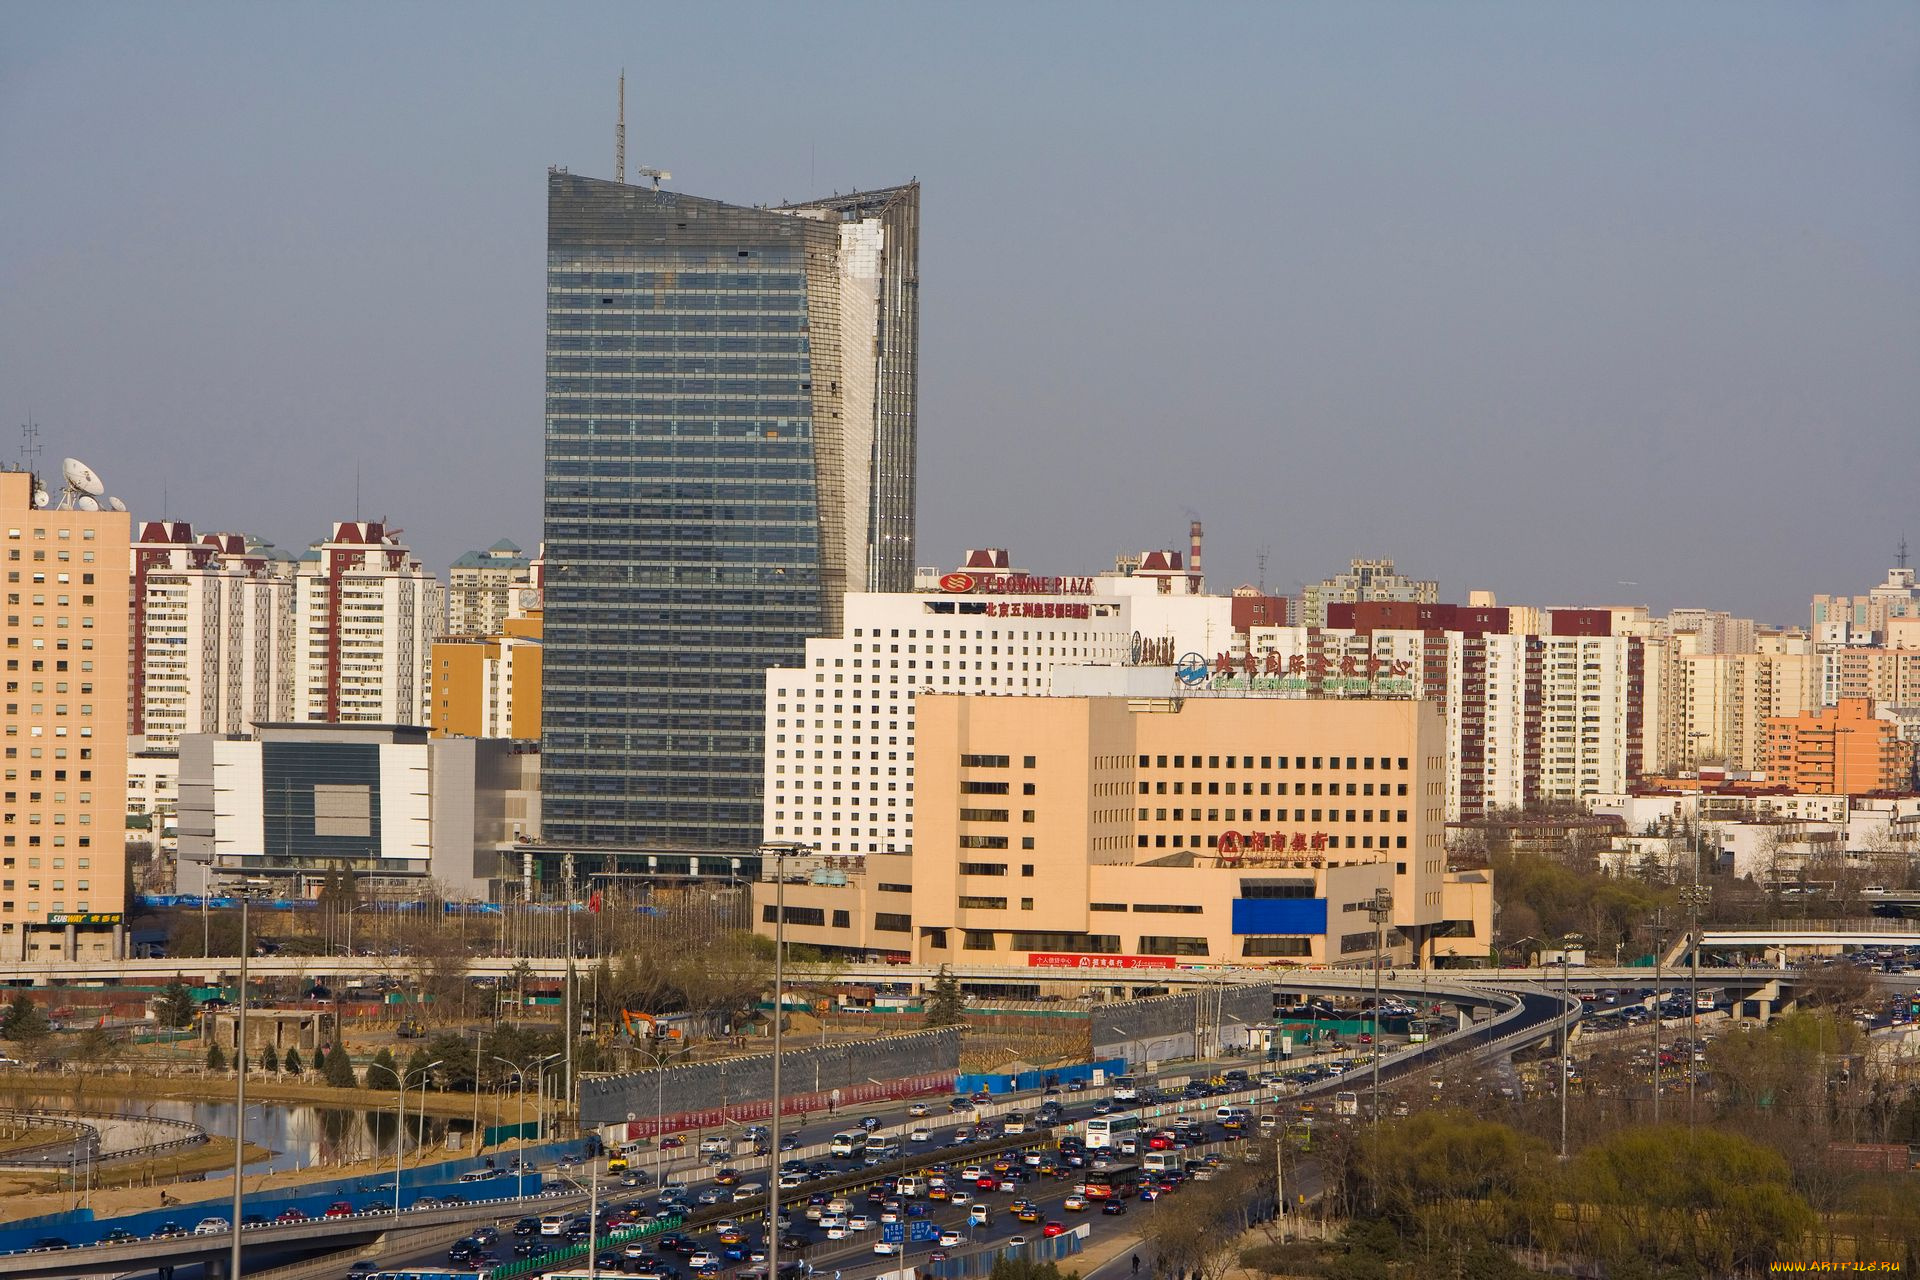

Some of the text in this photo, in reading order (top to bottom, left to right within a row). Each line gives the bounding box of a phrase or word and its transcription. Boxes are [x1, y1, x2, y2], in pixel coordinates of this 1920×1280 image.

[985, 577, 1093, 594] CROWNE PLAZA
[51, 914, 87, 923] SUBWAY
